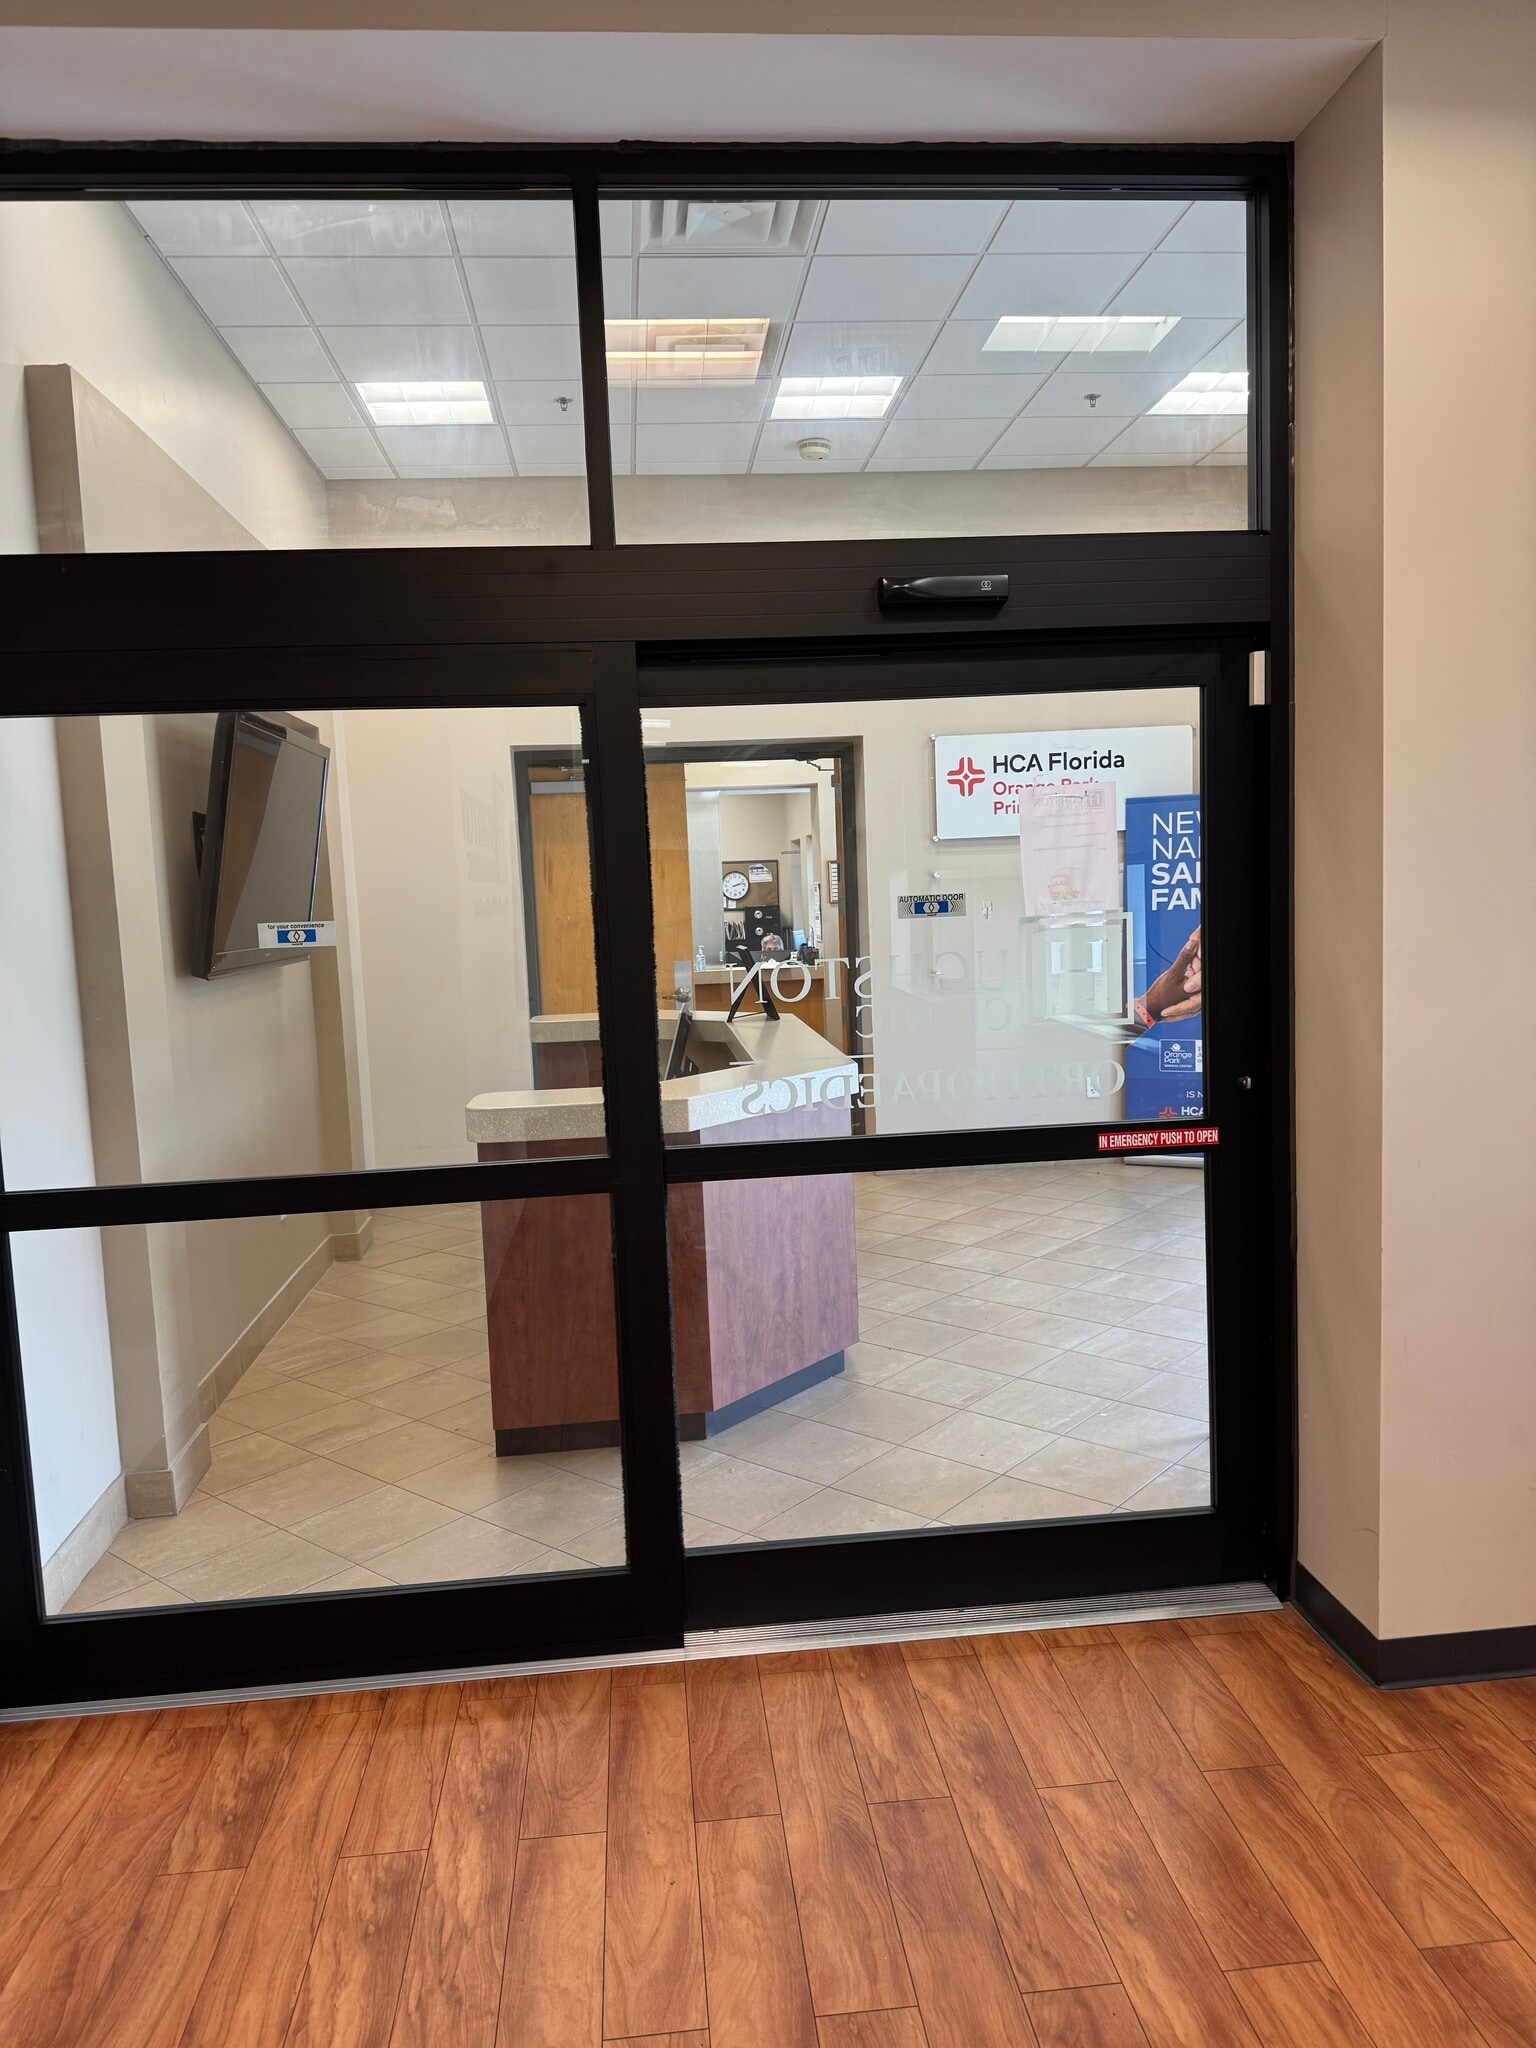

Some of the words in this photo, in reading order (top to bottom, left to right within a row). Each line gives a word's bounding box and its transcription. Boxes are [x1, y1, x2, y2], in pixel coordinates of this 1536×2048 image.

[993, 753, 1043, 774] HCA
[1048, 749, 1125, 771] Florida
[1153, 811, 1200, 835] NE
[1153, 836, 1200, 860] NA
[1151, 861, 1200, 886] SA
[899, 894, 941, 903] AUTOMATIC
[942, 893, 964, 901] DOOR
[1163, 1050, 1192, 1059] Orange
[1186, 1090, 1196, 1098] IS
[1099, 1135, 1108, 1148] IN
[1109, 1132, 1159, 1148] EMERGENCY
[1160, 1130, 1182, 1145] PUSH
[1183, 1130, 1195, 1144] TO
[1196, 1129, 1219, 1143] OPEN
